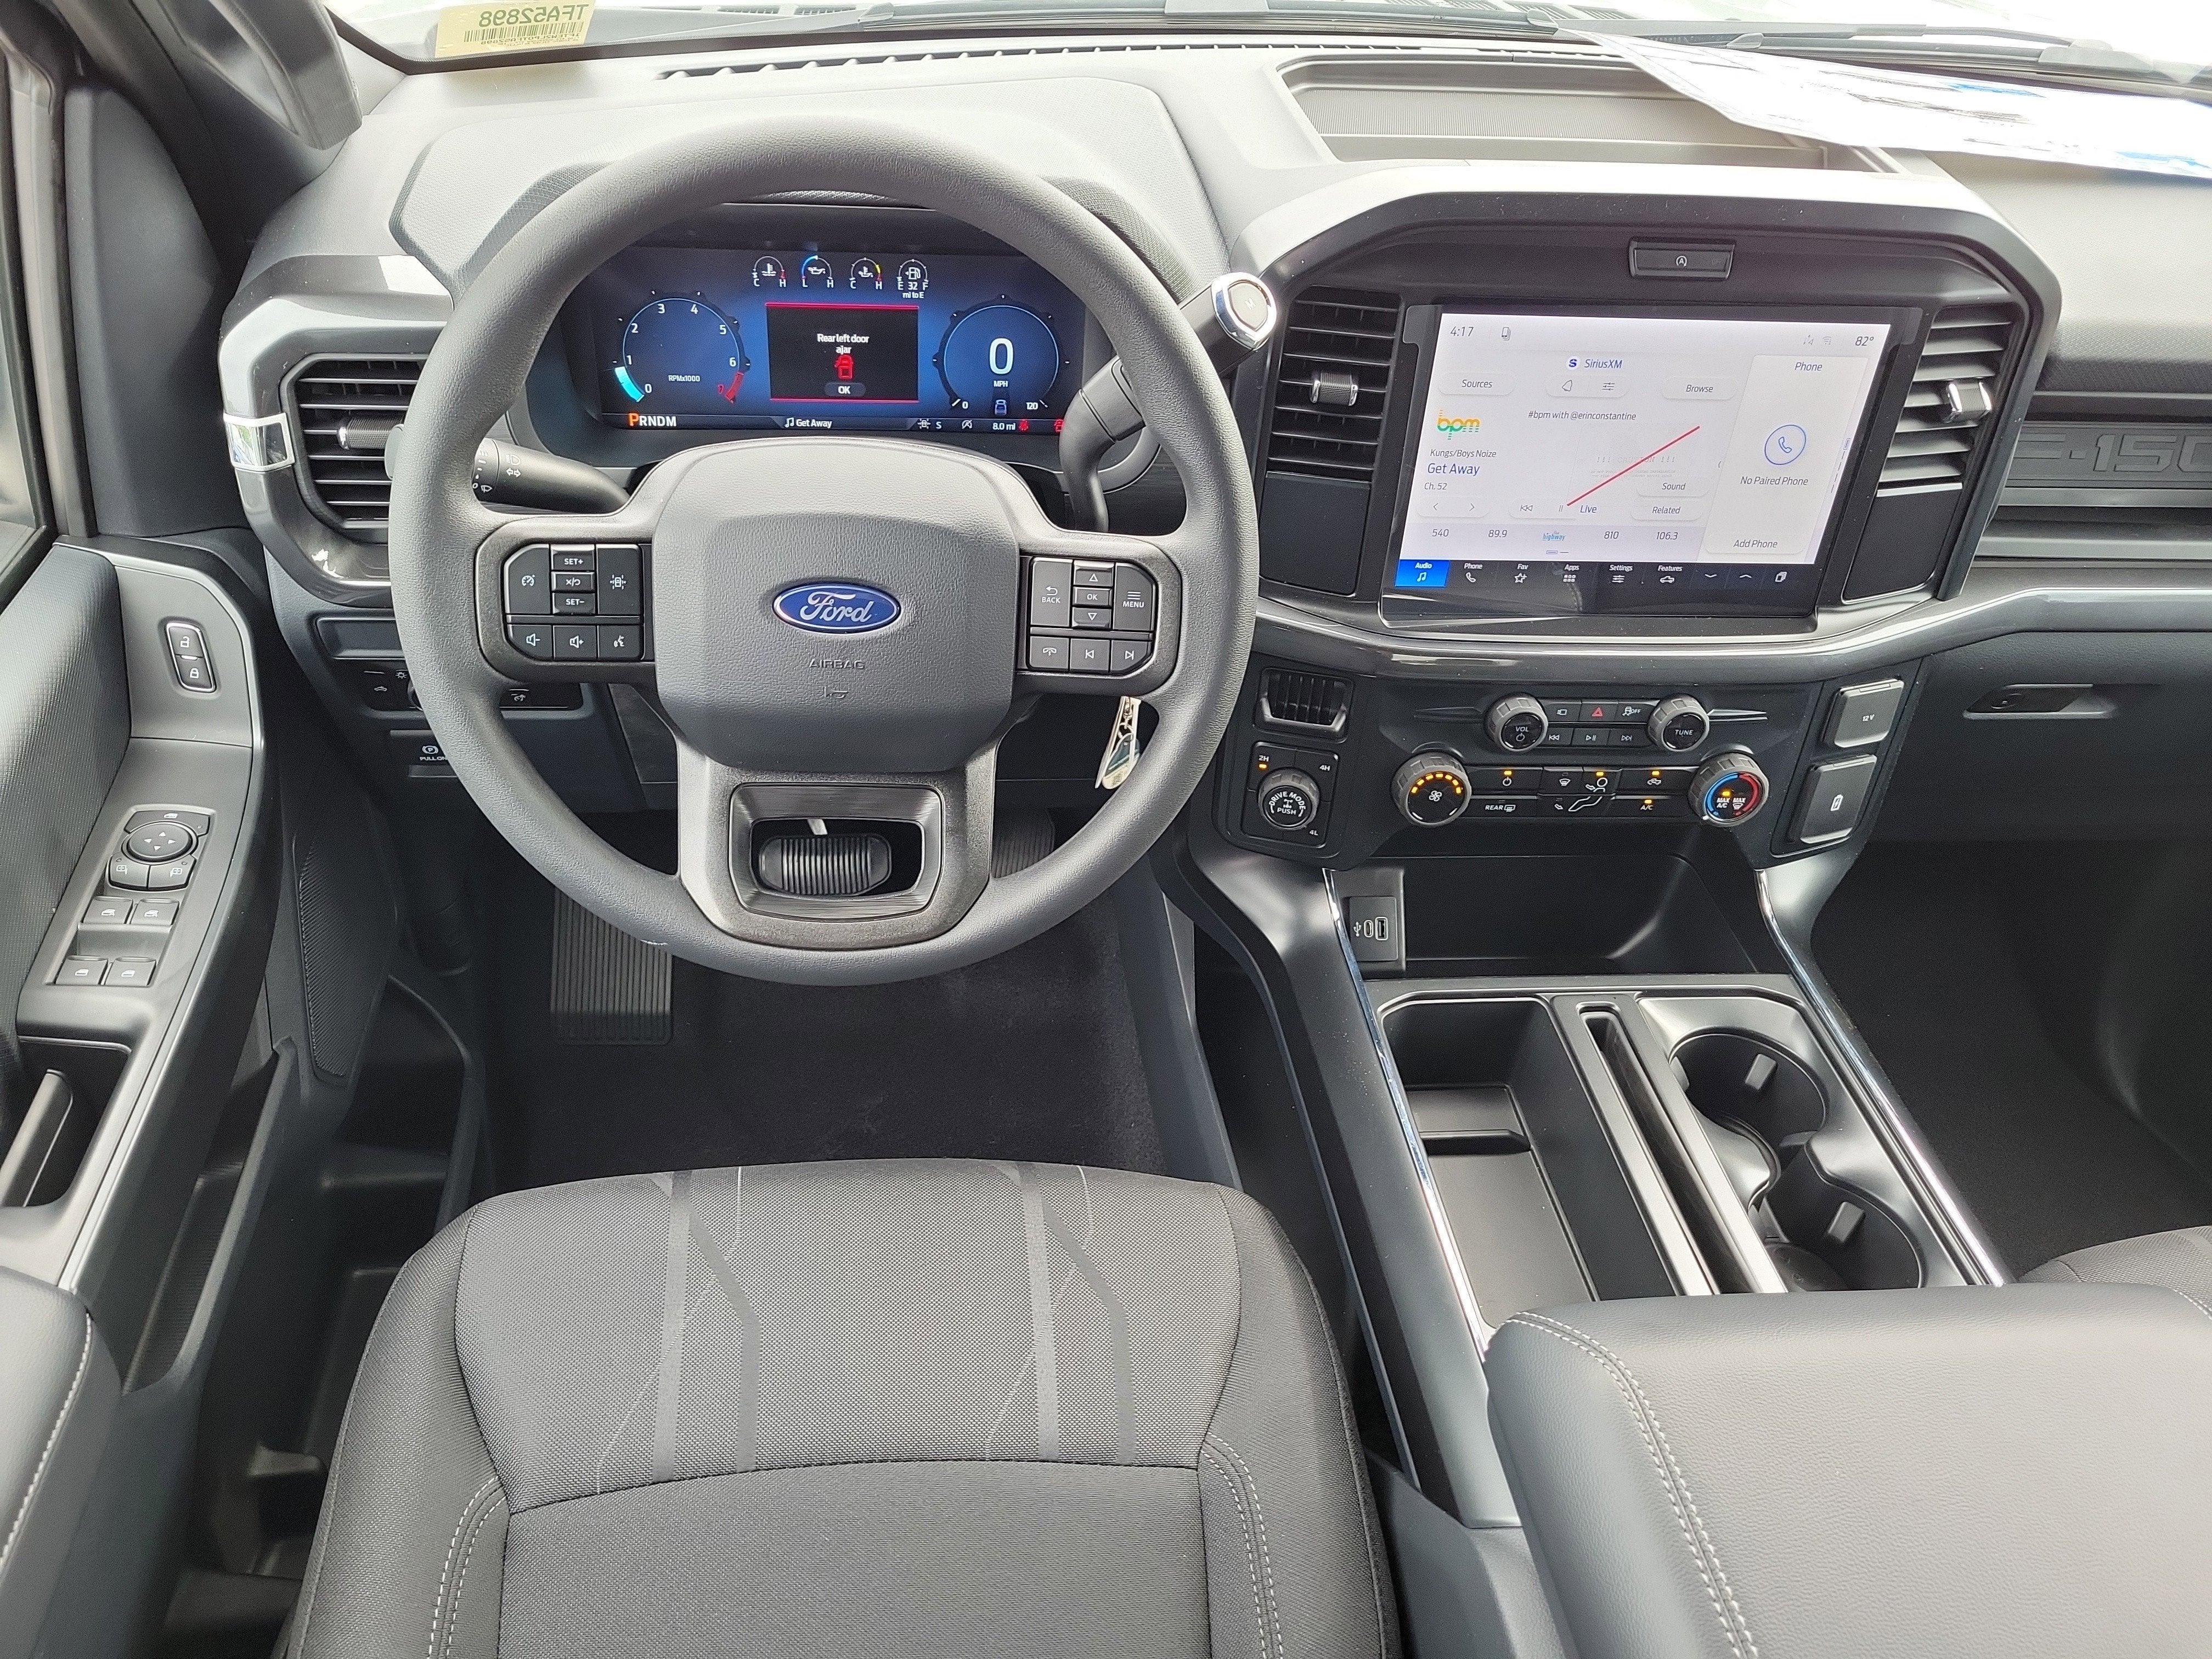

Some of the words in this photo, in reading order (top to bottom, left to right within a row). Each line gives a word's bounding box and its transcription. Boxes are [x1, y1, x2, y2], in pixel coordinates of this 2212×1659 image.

[754, 278, 760, 287] C
[780, 279, 786, 287] H
[827, 279, 834, 288] H
[850, 280, 856, 289] C
[876, 281, 882, 290] H
[898, 281, 903, 290] E
[907, 282, 918, 290] 32
[923, 282, 928, 290] F
[1245, 297, 1256, 310] M
[658, 303, 665, 314] 3
[691, 304, 698, 314] 4
[631, 323, 639, 334] 2
[719, 325, 727, 335] 5
[1451, 326, 1474, 337] 4:17
[817, 334, 835, 343] Rear
[836, 334, 850, 343] left
[851, 335, 870, 343] door
[836, 345, 851, 354] ajar
[627, 355, 632, 365] 1
[989, 338, 1014, 374] 0
[729, 357, 736, 367] 6
[1584, 359, 1623, 369] SiriusXM
[1795, 362, 1822, 372] Phone
[645, 383, 652, 393] 0
[1462, 379, 1492, 388] Sources
[838, 386, 851, 394] OK
[1686, 384, 1713, 393] Browse
[1528, 411, 1551, 421] #bpm
[1552, 411, 1569, 419] with
[1570, 412, 1637, 421] @erinconstantine
[796, 419, 810, 427] Get
[811, 419, 832, 428] Away
[1437, 409, 1480, 440] bpm
[1430, 449, 1475, 459] Kungs/Boys
[1427, 463, 1447, 474] Get
[1449, 464, 1480, 476] Away
[1740, 476, 1752, 485] No
[1754, 476, 1781, 486] Paired
[1782, 477, 1808, 486] Phone
[1424, 482, 1436, 490] Ch.
[1437, 482, 1447, 490] 52
[1662, 482, 1686, 490] Sound
[1580, 505, 1597, 514] Live
[1652, 506, 1681, 514] Related
[1432, 528, 1449, 537] 540
[1488, 529, 1508, 538] 89.9
[1543, 533, 1566, 541] highway
[1604, 531, 1619, 540] 810
[1656, 532, 1678, 540] 106.3
[1734, 539, 1750, 548] Add
[1752, 540, 1778, 548] Phone
[1565, 564, 1579, 572] Apps
[1609, 564, 1633, 572] Settings
[800, 591, 874, 623] Ford
[809, 659, 865, 669] AIRBAG
[1269, 791, 1288, 806] DRIVE
[1289, 792, 1306, 810] MODE
